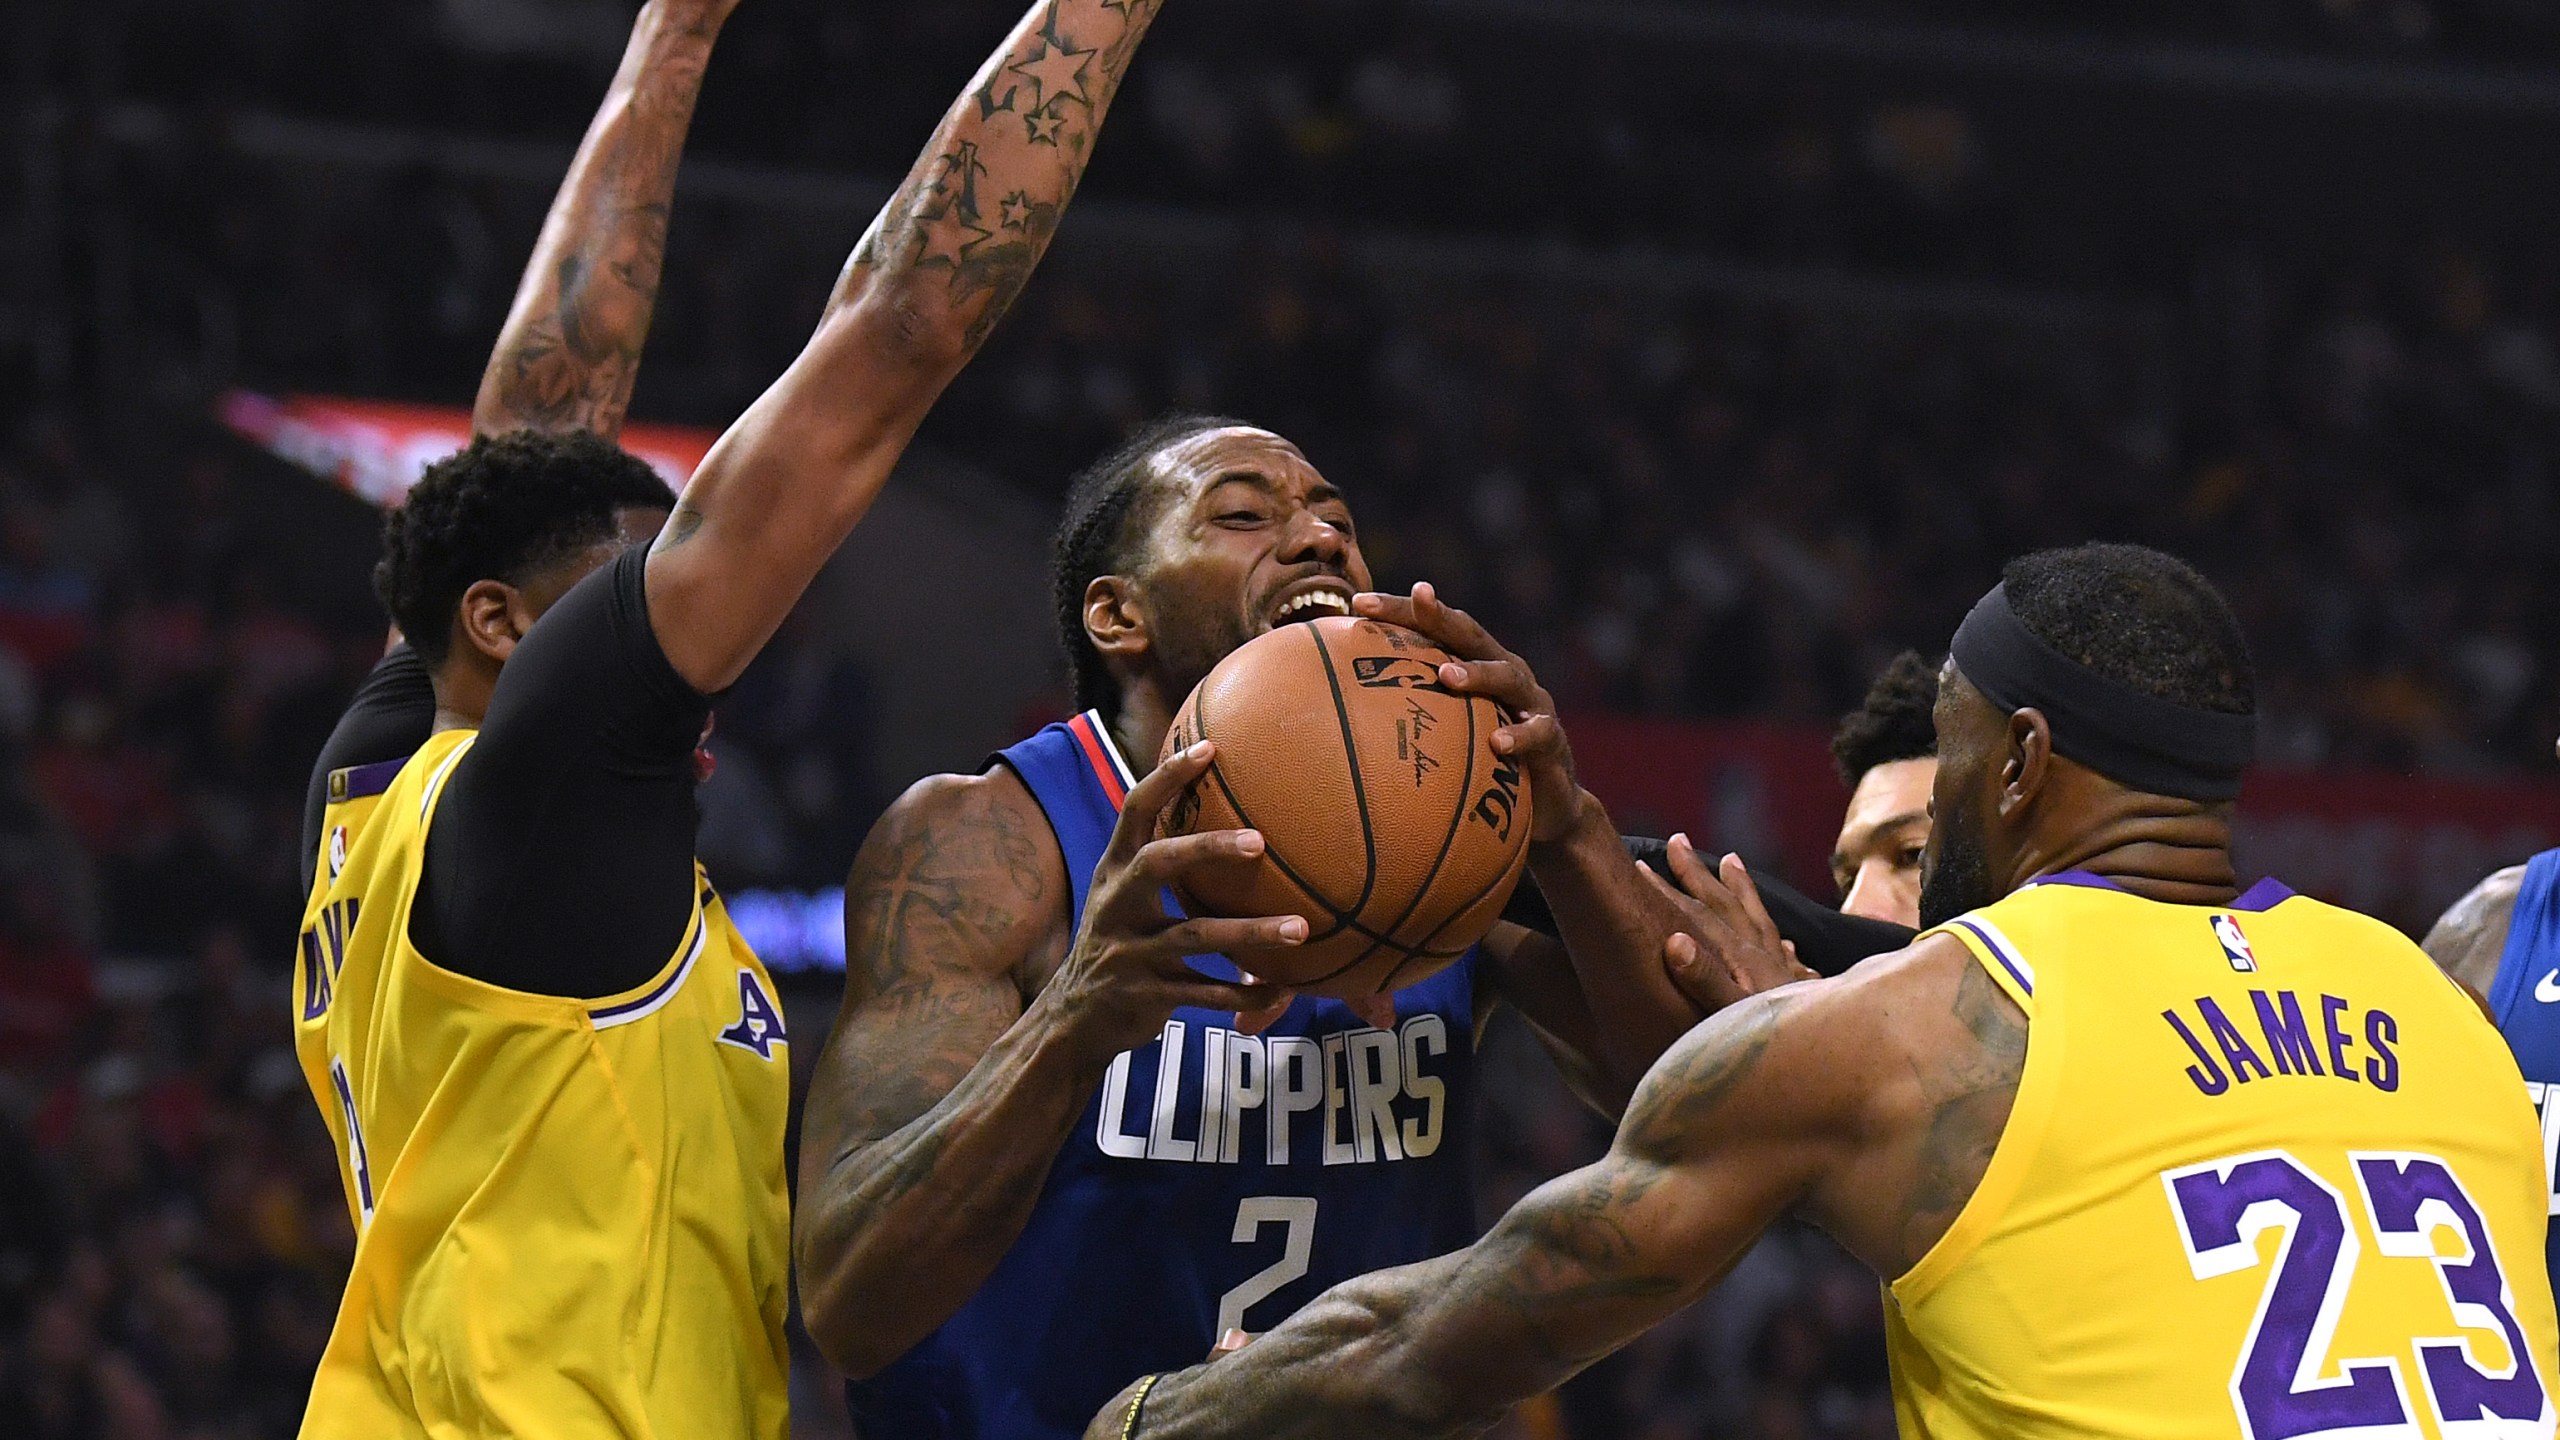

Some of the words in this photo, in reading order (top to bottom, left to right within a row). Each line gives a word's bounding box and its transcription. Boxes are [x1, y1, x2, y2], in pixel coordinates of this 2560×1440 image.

[1096, 1012, 1447, 1167] CLIPPERS
[2161, 988, 2399, 1097] JAMES
[1215, 1195, 1319, 1347] 2
[2159, 1148, 2557, 1440] 23
